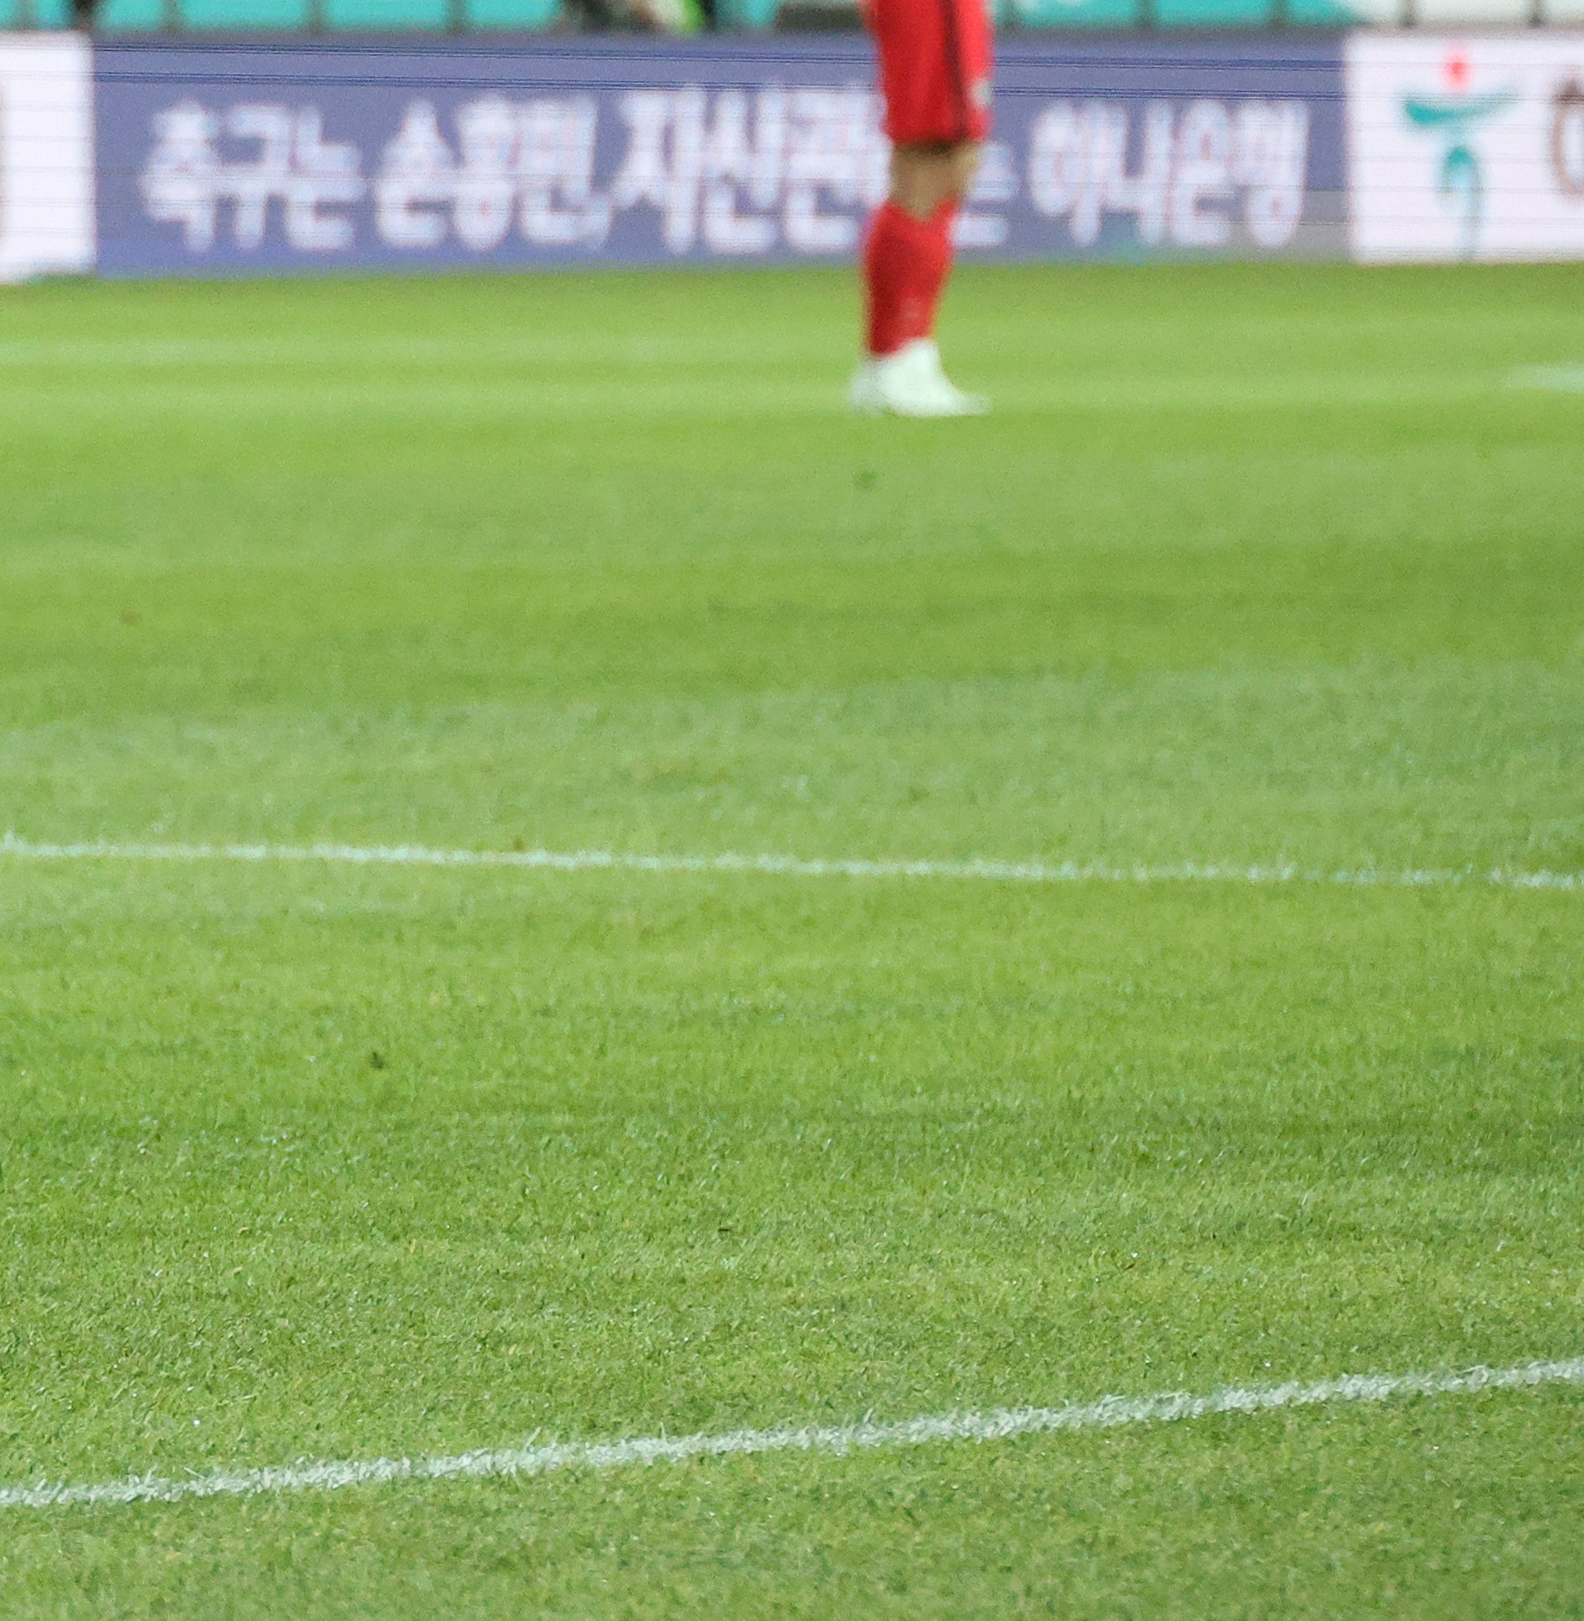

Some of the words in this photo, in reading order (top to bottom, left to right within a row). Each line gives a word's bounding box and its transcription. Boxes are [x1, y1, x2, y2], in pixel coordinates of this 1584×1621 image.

[141, 97, 366, 255] 축구는
[613, 80, 1021, 257] 자산관는
[1031, 95, 1314, 249] 하나은행
